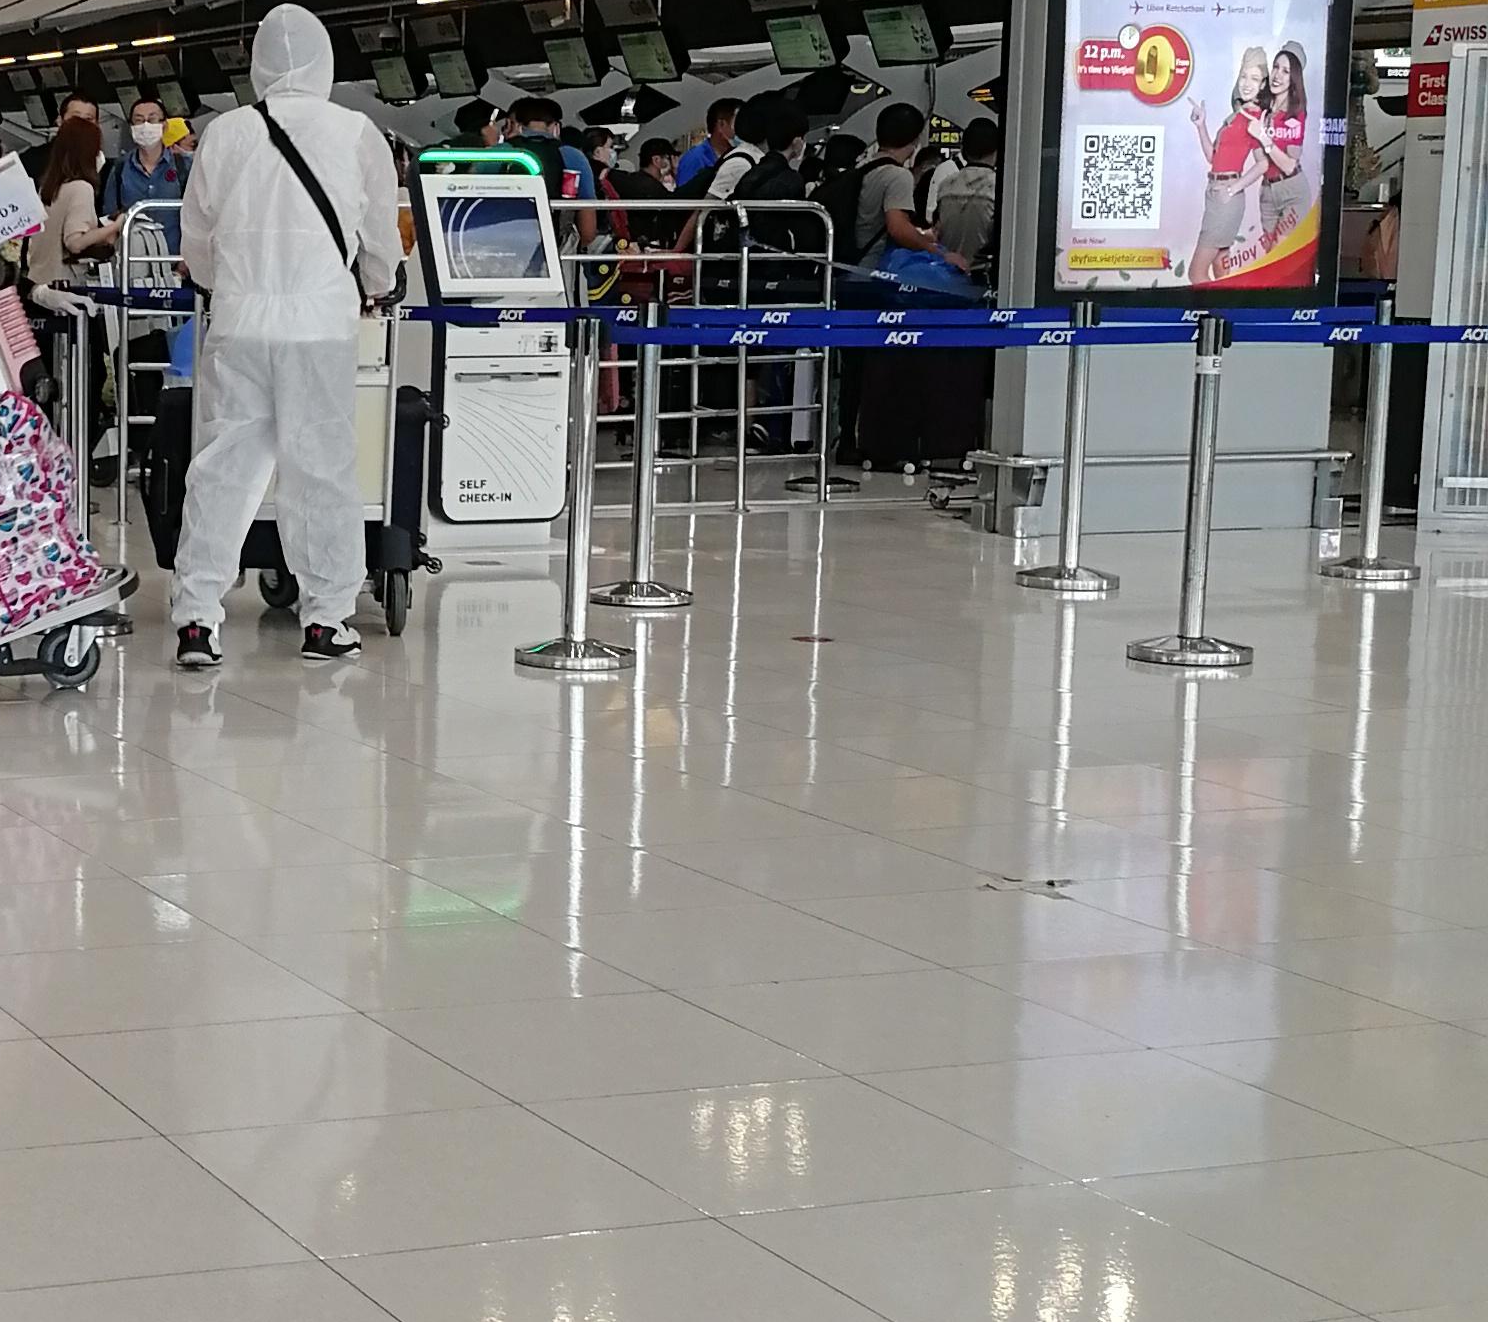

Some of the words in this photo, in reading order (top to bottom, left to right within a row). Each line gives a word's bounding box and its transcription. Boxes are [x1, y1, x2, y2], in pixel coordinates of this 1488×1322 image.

[1443, 25, 1488, 42] SWISS
[1084, 45, 1098, 59] 12
[1100, 47, 1125, 61] p.m.
[1419, 74, 1446, 88] First
[1221, 245, 1257, 270] Enjoy
[870, 269, 898, 281] AOT
[149, 288, 174, 298] AOT
[497, 309, 526, 321] AOT
[616, 311, 638, 322] AO
[761, 311, 791, 324] AOT
[877, 311, 906, 324] AOT
[989, 310, 1017, 322] AOT
[1291, 309, 1319, 321] AOT
[729, 330, 768, 345] AOT
[884, 331, 923, 345] AOT
[1039, 330, 1076, 344] AOT
[1328, 327, 1363, 341] AOT
[459, 479, 487, 490] SELF
[459, 492, 512, 503] CHECK-IN
